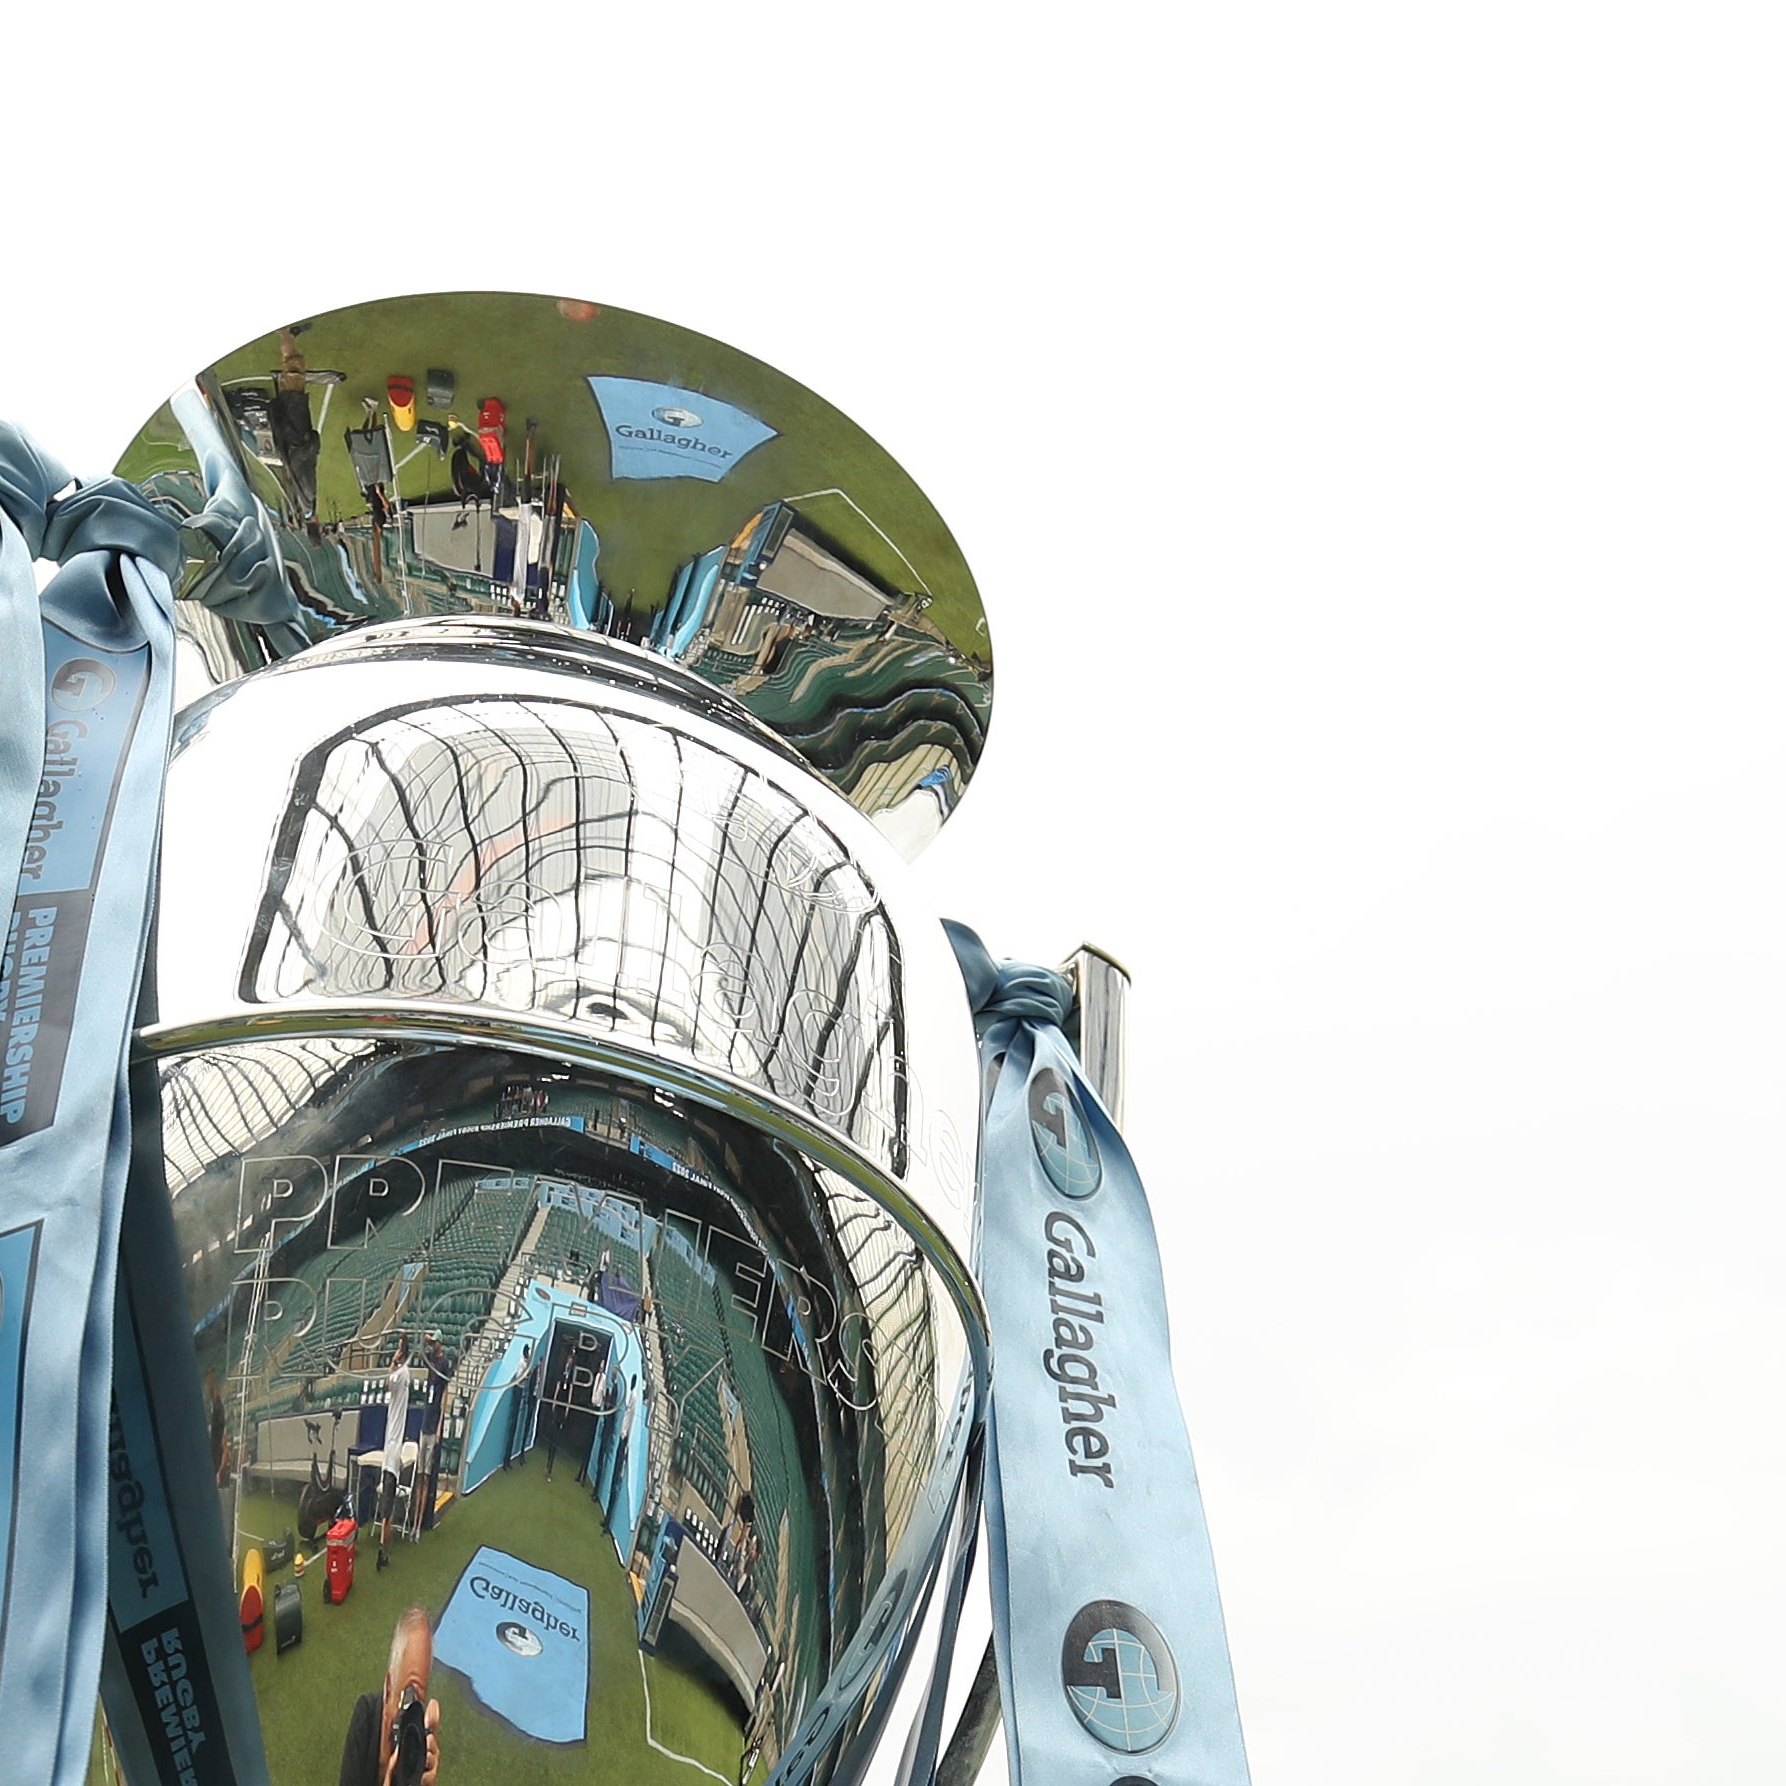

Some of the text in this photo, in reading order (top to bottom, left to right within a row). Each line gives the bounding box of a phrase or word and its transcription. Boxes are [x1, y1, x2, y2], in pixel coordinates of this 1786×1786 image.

[615, 424, 733, 460] Gallagher
[0, 906, 58, 1125] PREMIERSHIP
[1044, 1211, 1117, 1489] Gallagher
